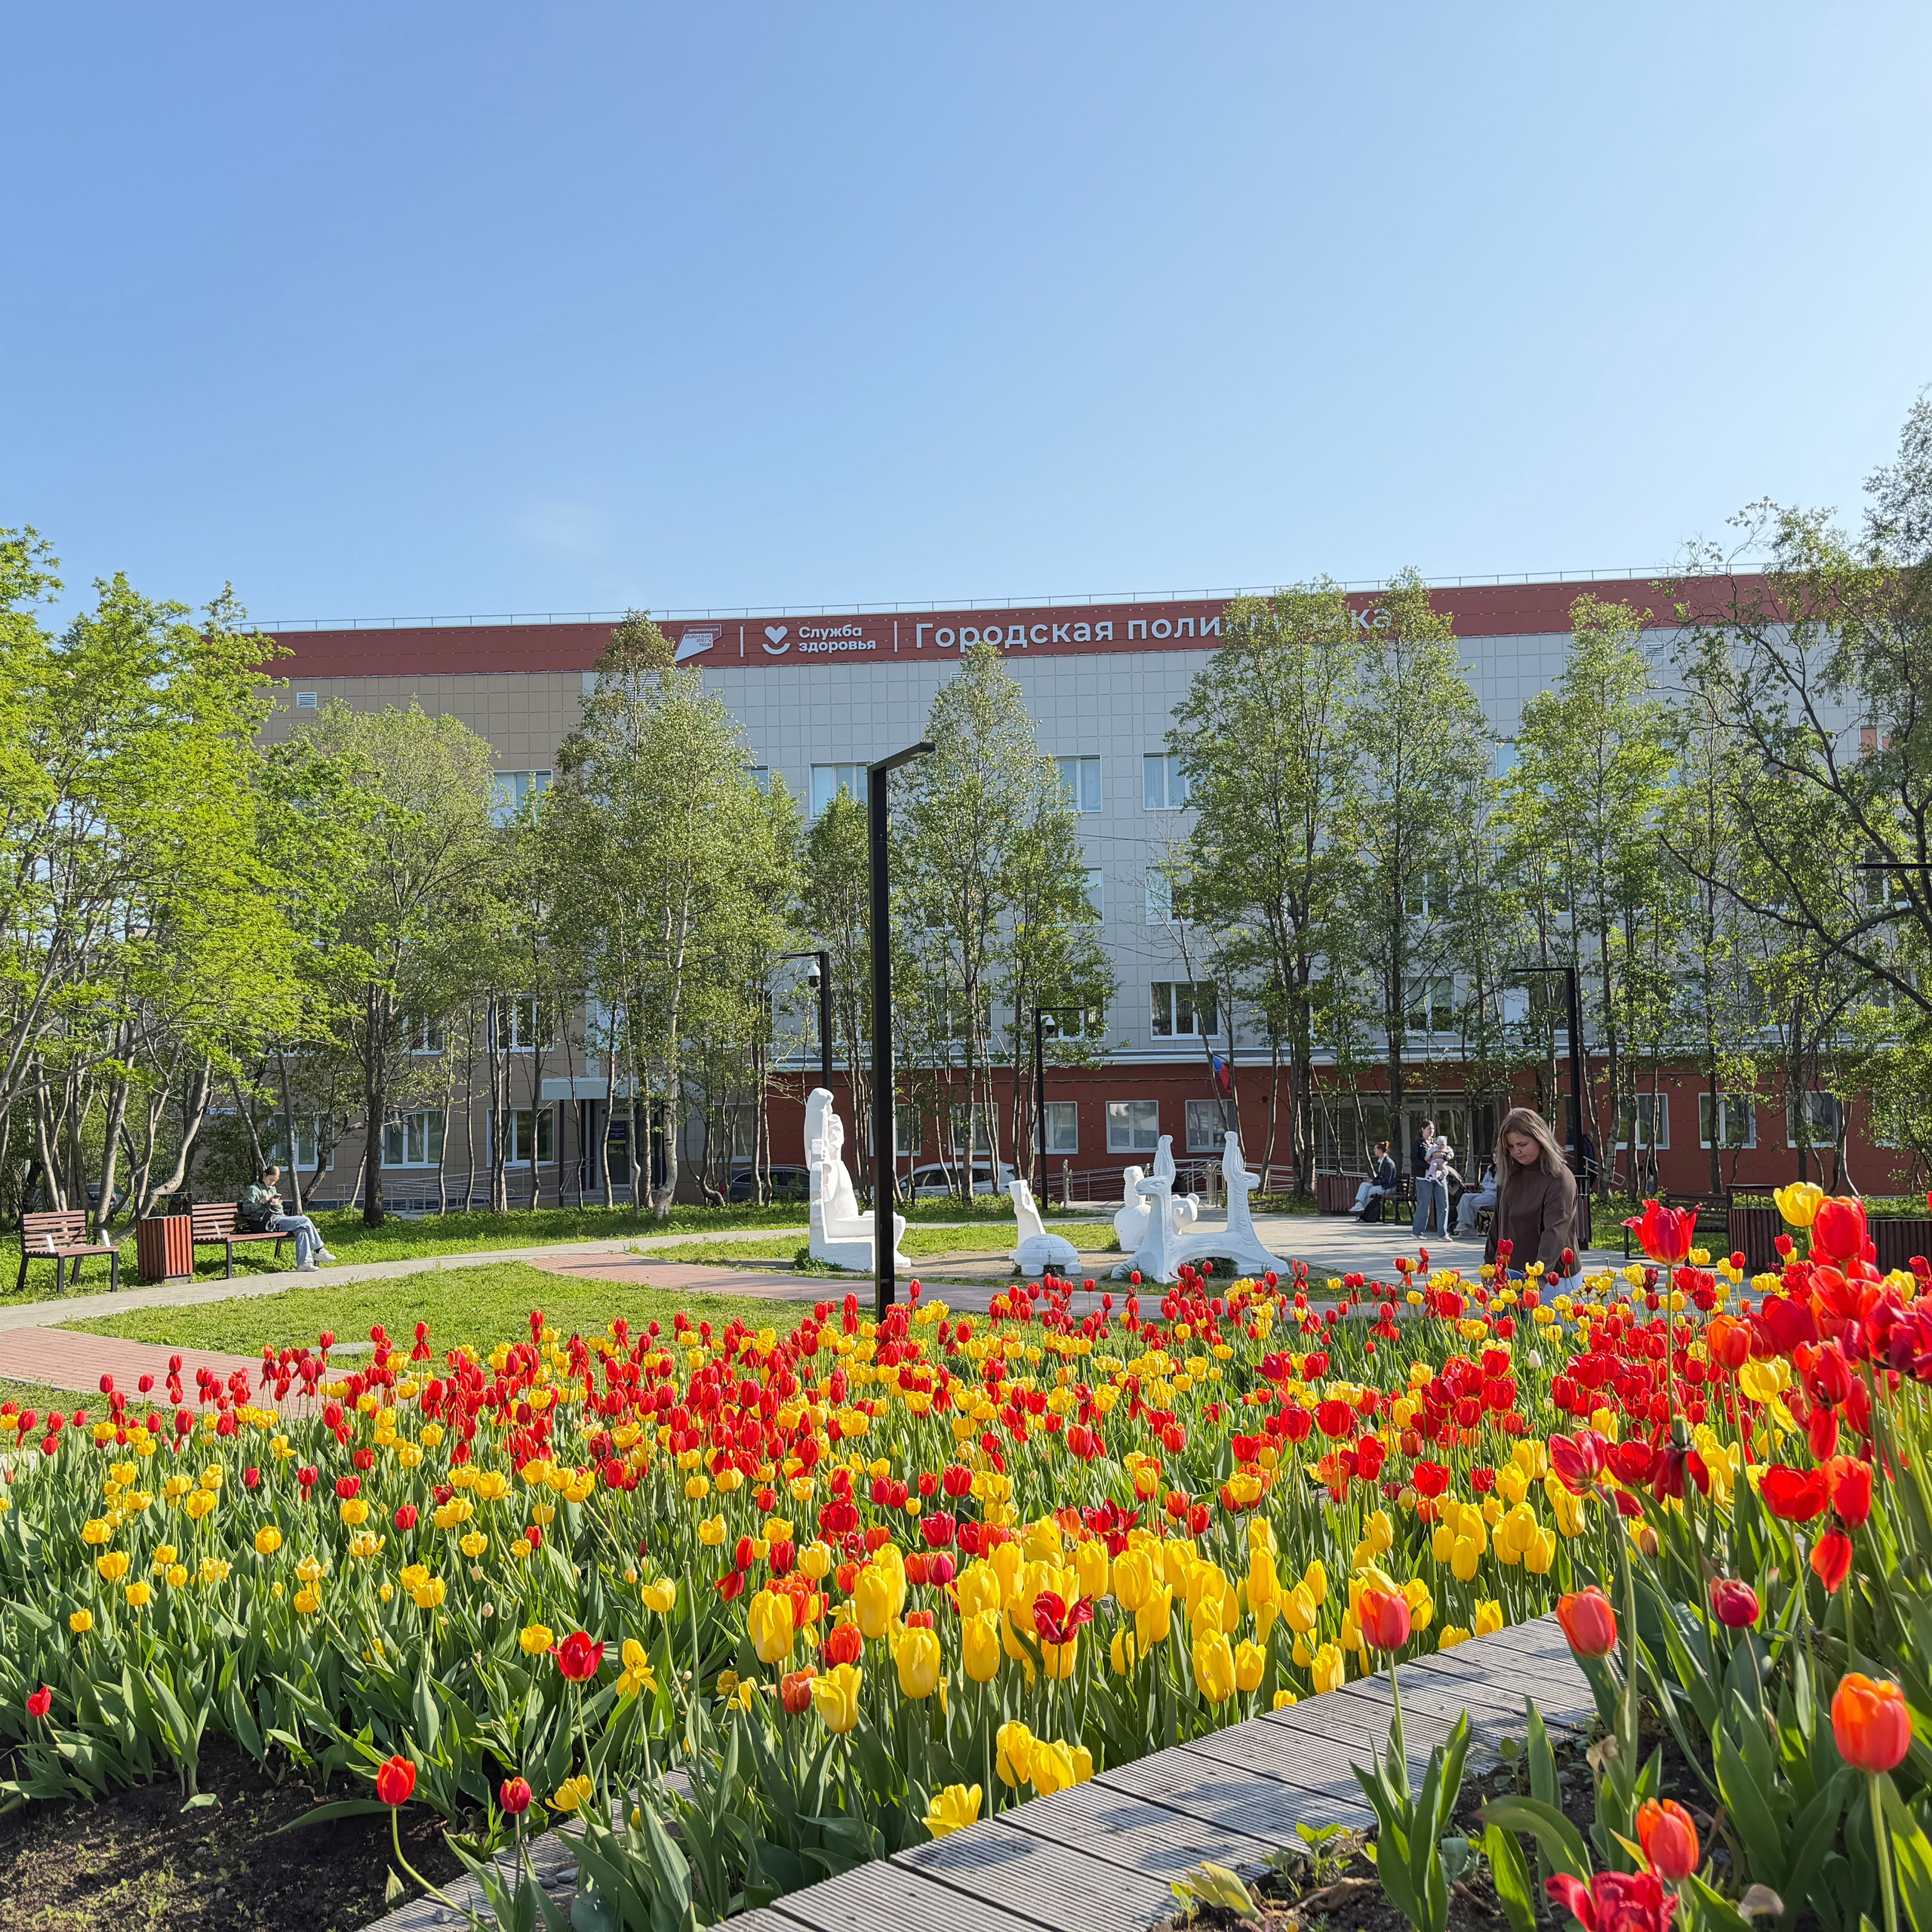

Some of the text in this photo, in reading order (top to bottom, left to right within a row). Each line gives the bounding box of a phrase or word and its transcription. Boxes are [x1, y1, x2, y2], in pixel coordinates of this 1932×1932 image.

[798, 623, 863, 641] Служба
[915, 608, 1392, 653] Городская полика
[798, 640, 876, 654] здоровья
